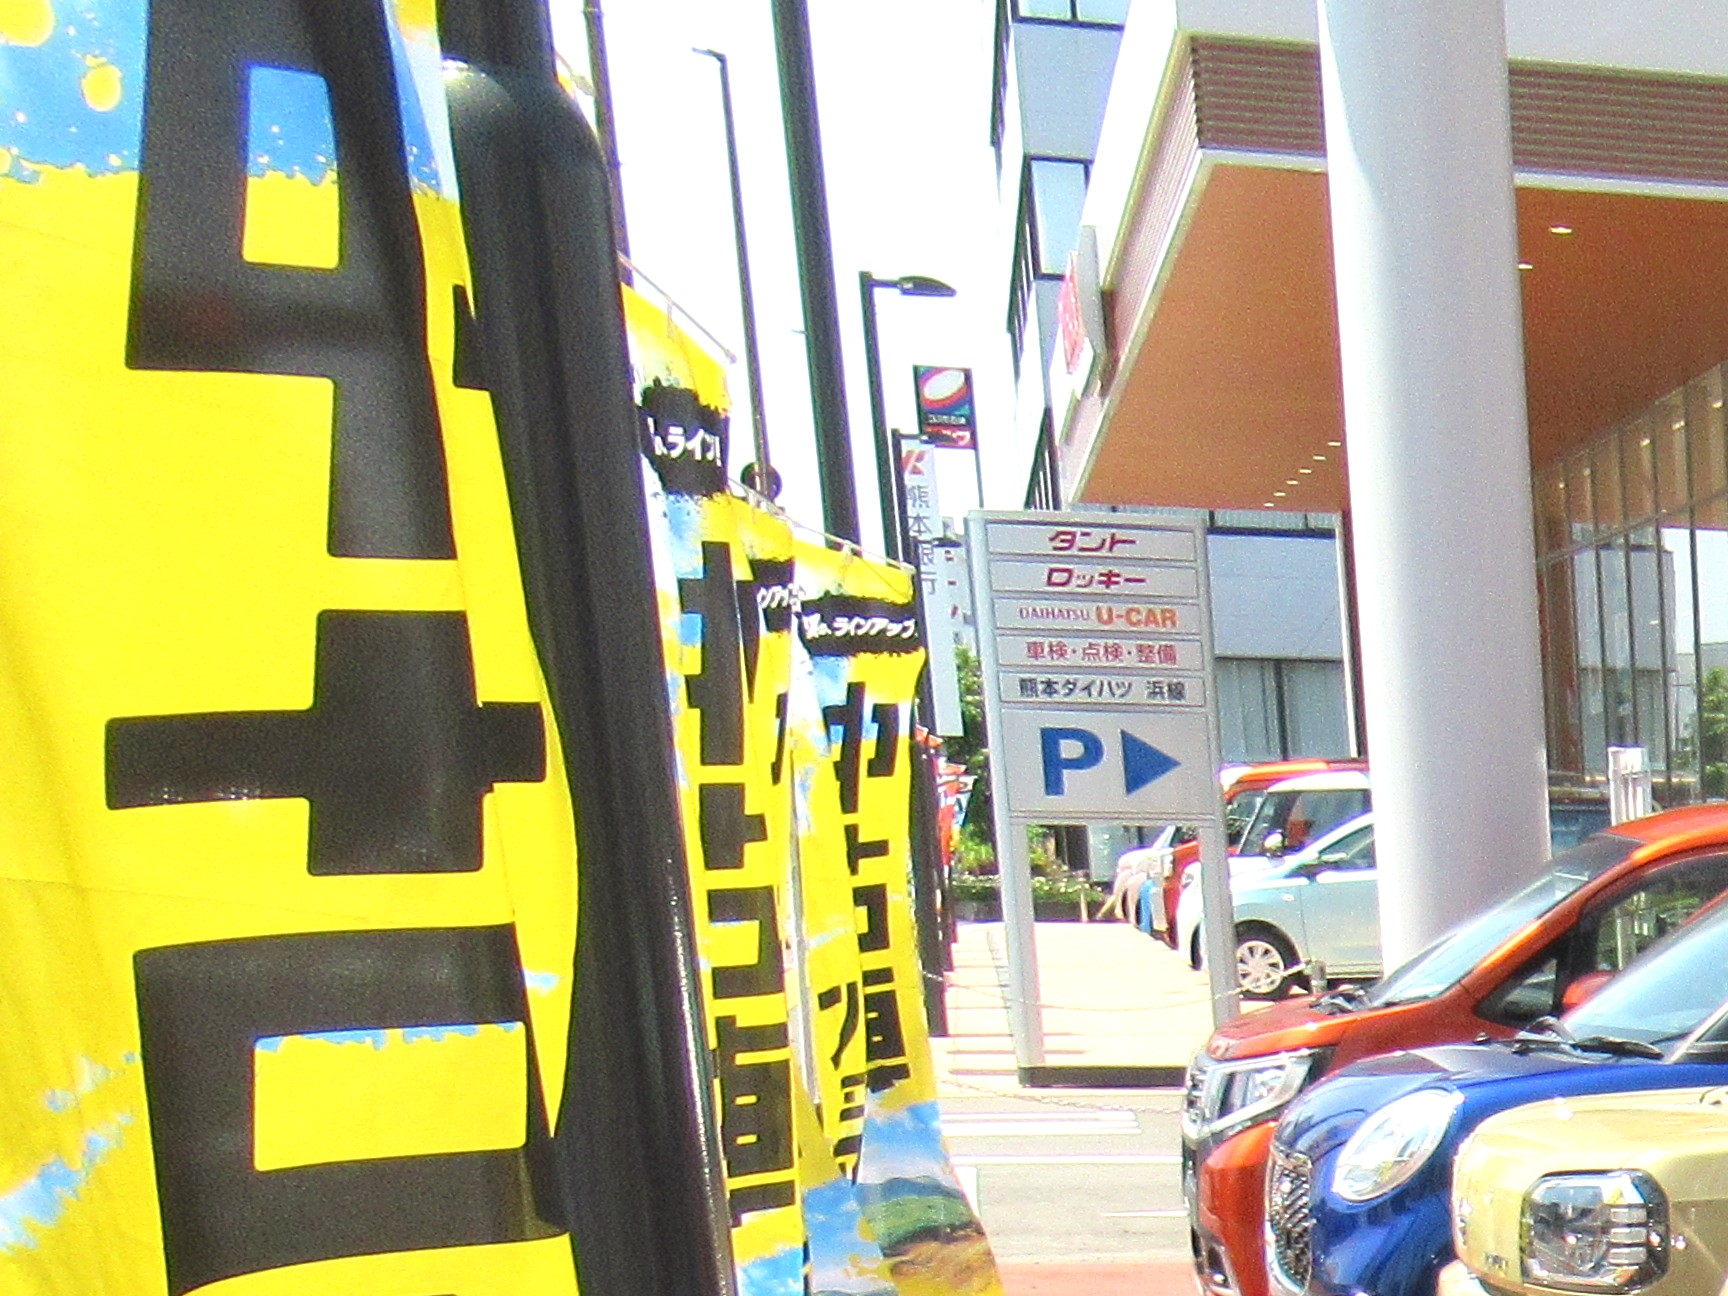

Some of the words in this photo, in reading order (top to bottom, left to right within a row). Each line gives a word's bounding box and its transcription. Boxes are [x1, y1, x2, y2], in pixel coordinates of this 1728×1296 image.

[1049, 530, 1137, 552] タント
[1046, 567, 1146, 589] ロッキー
[1019, 606, 1090, 622] DAIHATSU
[1094, 605, 1179, 628] U-CAR
[1025, 640, 1179, 665] 車検・点検・整備
[1018, 678, 1133, 699] 熊本ダイハツ
[1040, 726, 1103, 797] P
